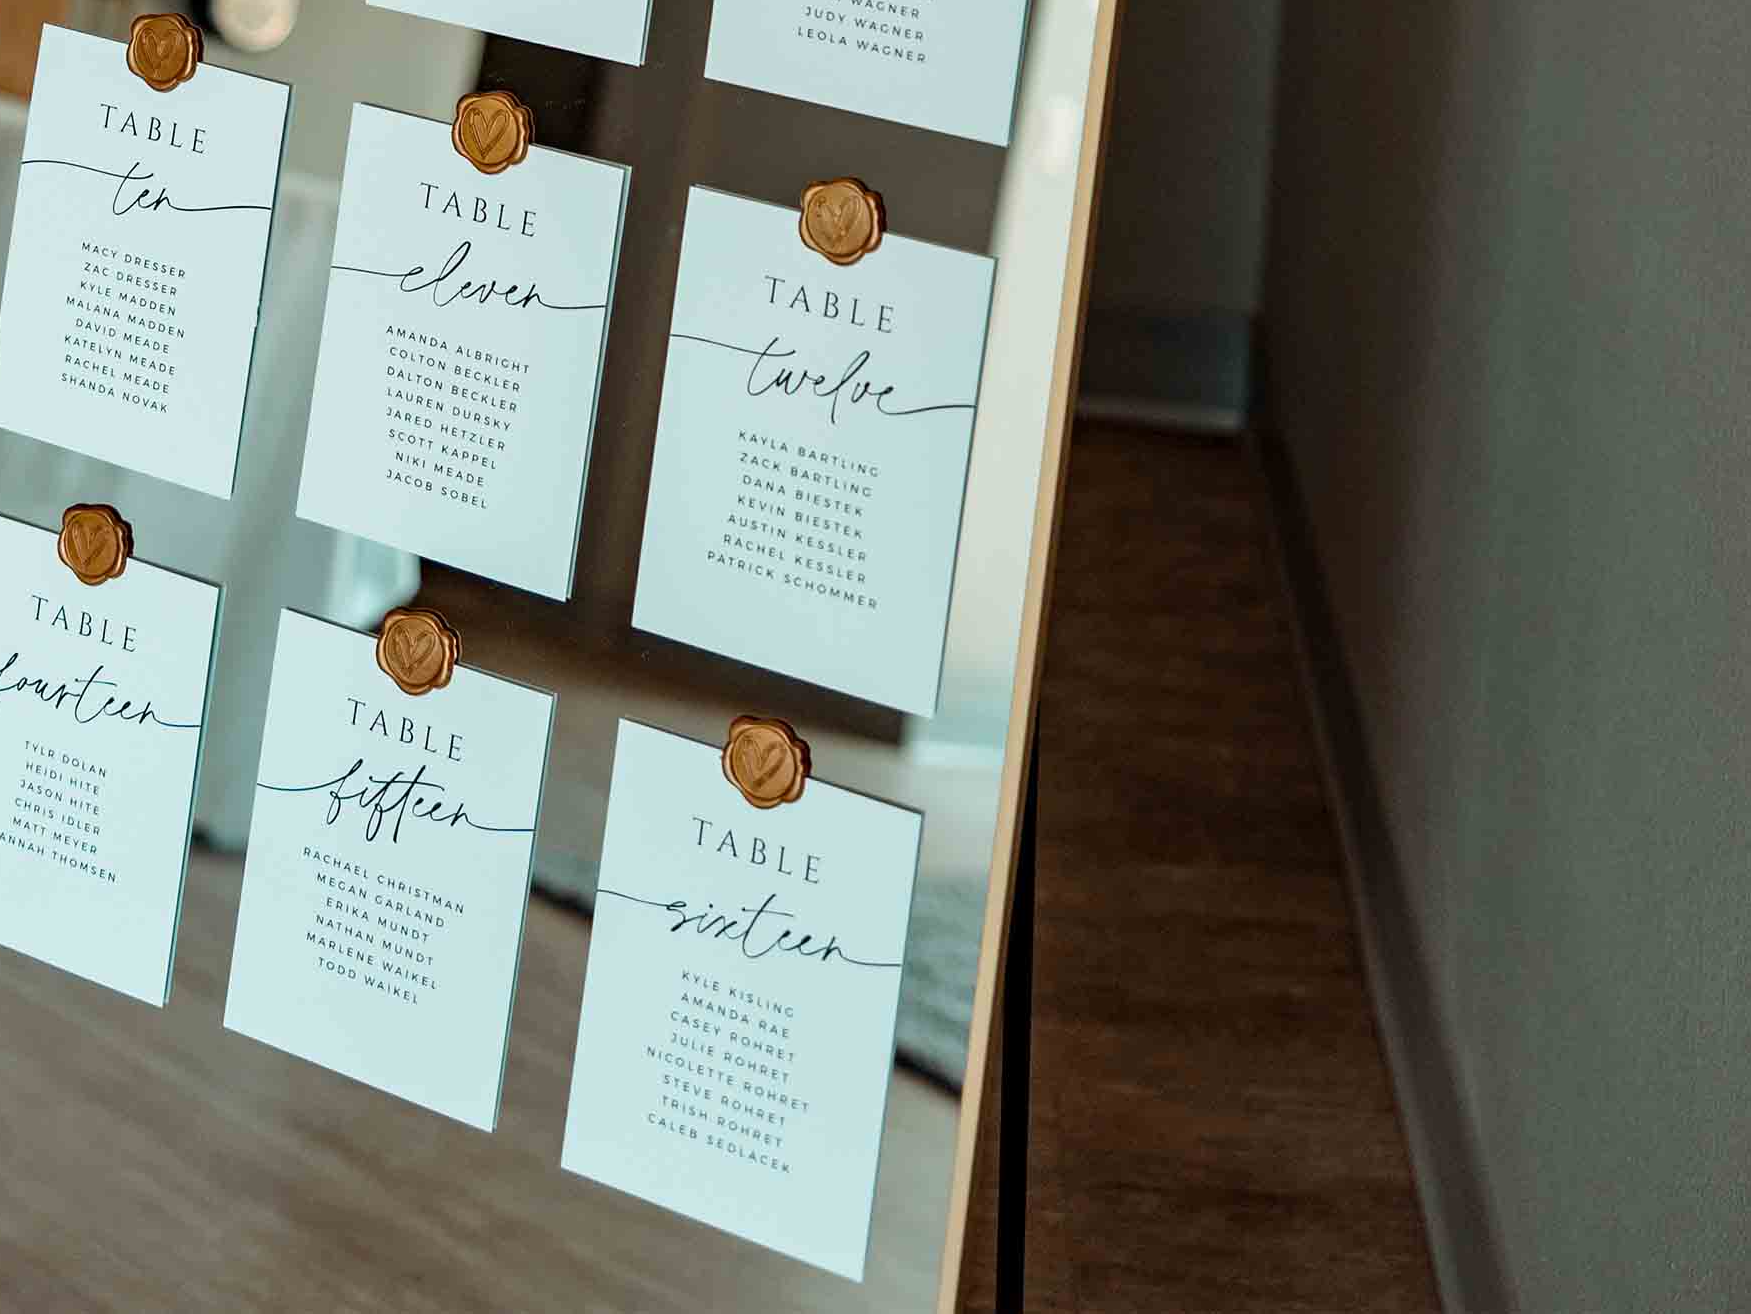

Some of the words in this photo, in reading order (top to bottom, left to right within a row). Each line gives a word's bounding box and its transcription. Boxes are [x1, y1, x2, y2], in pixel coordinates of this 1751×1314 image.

[100, 104, 208, 154] TABLE
[420, 182, 538, 237] TABLE
[80, 240, 118, 260] MACY
[123, 252, 187, 279] DRESSER
[82, 260, 110, 278] ZAC
[115, 270, 178, 297] DRESSER
[399, 241, 551, 307] eleven
[765, 276, 895, 333] TABLE
[74, 316, 118, 339] DAVID
[122, 331, 171, 355] MEADE
[60, 371, 116, 399] SHANDA
[121, 390, 168, 415] NOVAK
[385, 364, 444, 392] DALTON
[449, 383, 518, 413] BECKLER
[747, 337, 902, 424] twelve
[386, 387, 445, 413] LAUREN
[451, 405, 512, 432] DURSKY
[387, 427, 435, 451] SCOTT
[440, 443, 497, 471] KAPPEL
[385, 467, 434, 493] JACOB
[439, 485, 487, 511] SOBEL
[31, 595, 137, 653] TABLE
[347, 698, 465, 761] TABLE
[326, 758, 483, 843] fifteen
[692, 817, 822, 884] TABLE
[325, 895, 370, 923] ERIKA
[376, 915, 430, 943] MUNDT
[665, 894, 852, 964] sixteen
[317, 955, 358, 981] TODD
[363, 974, 419, 1006] WAIKEL
